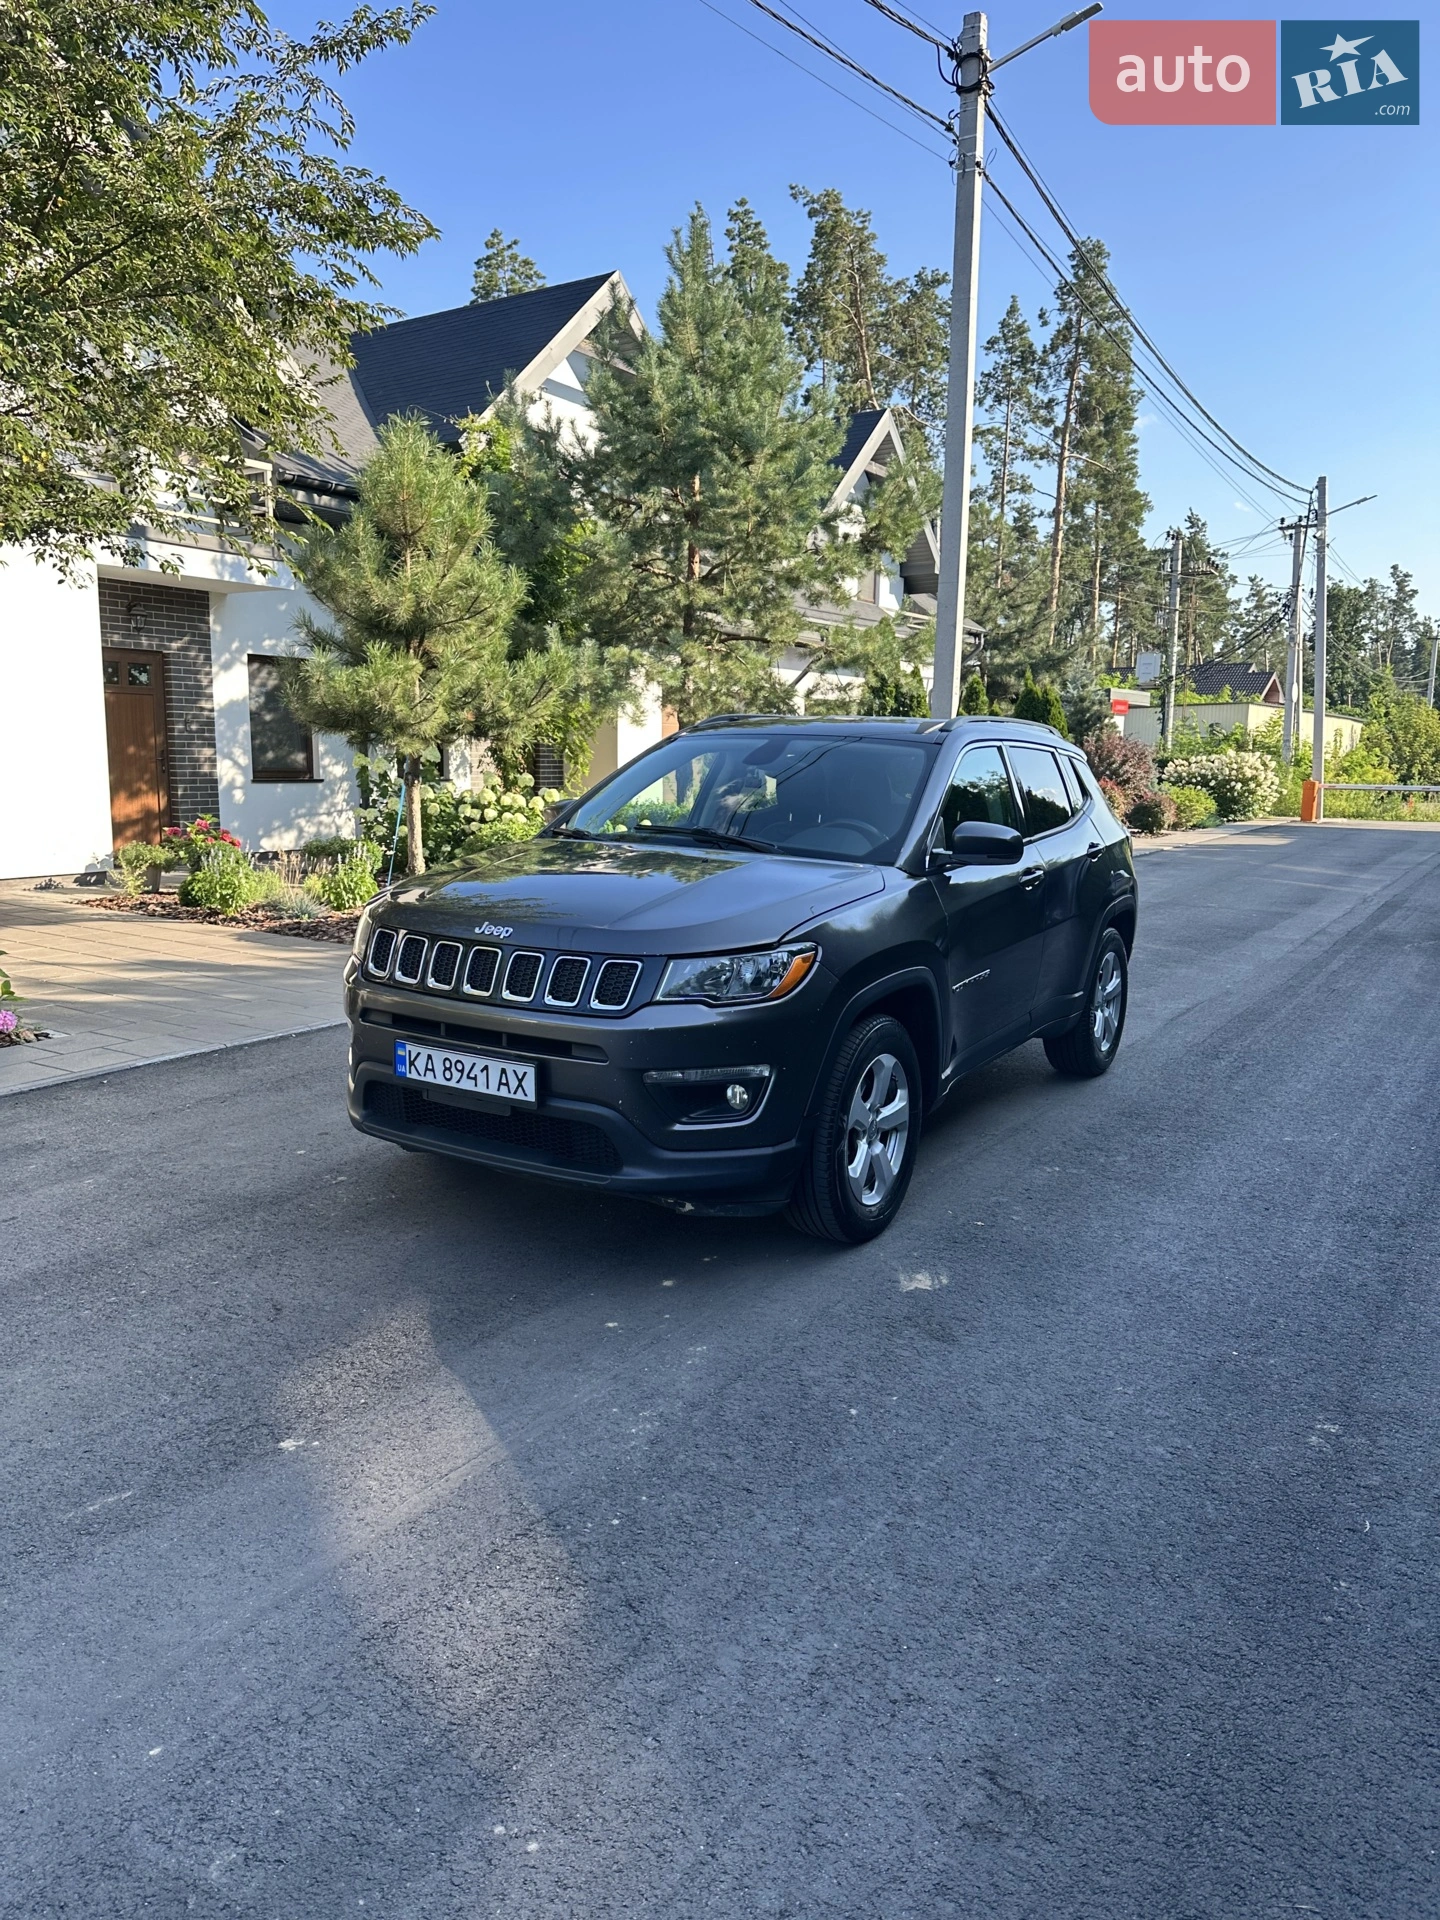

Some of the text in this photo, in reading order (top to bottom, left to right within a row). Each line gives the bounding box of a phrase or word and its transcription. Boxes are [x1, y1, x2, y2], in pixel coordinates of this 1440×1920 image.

[474, 921, 513, 939] Jeep
[397, 1064, 406, 1073] UA
[408, 1050, 528, 1097] KA 8941 AX
